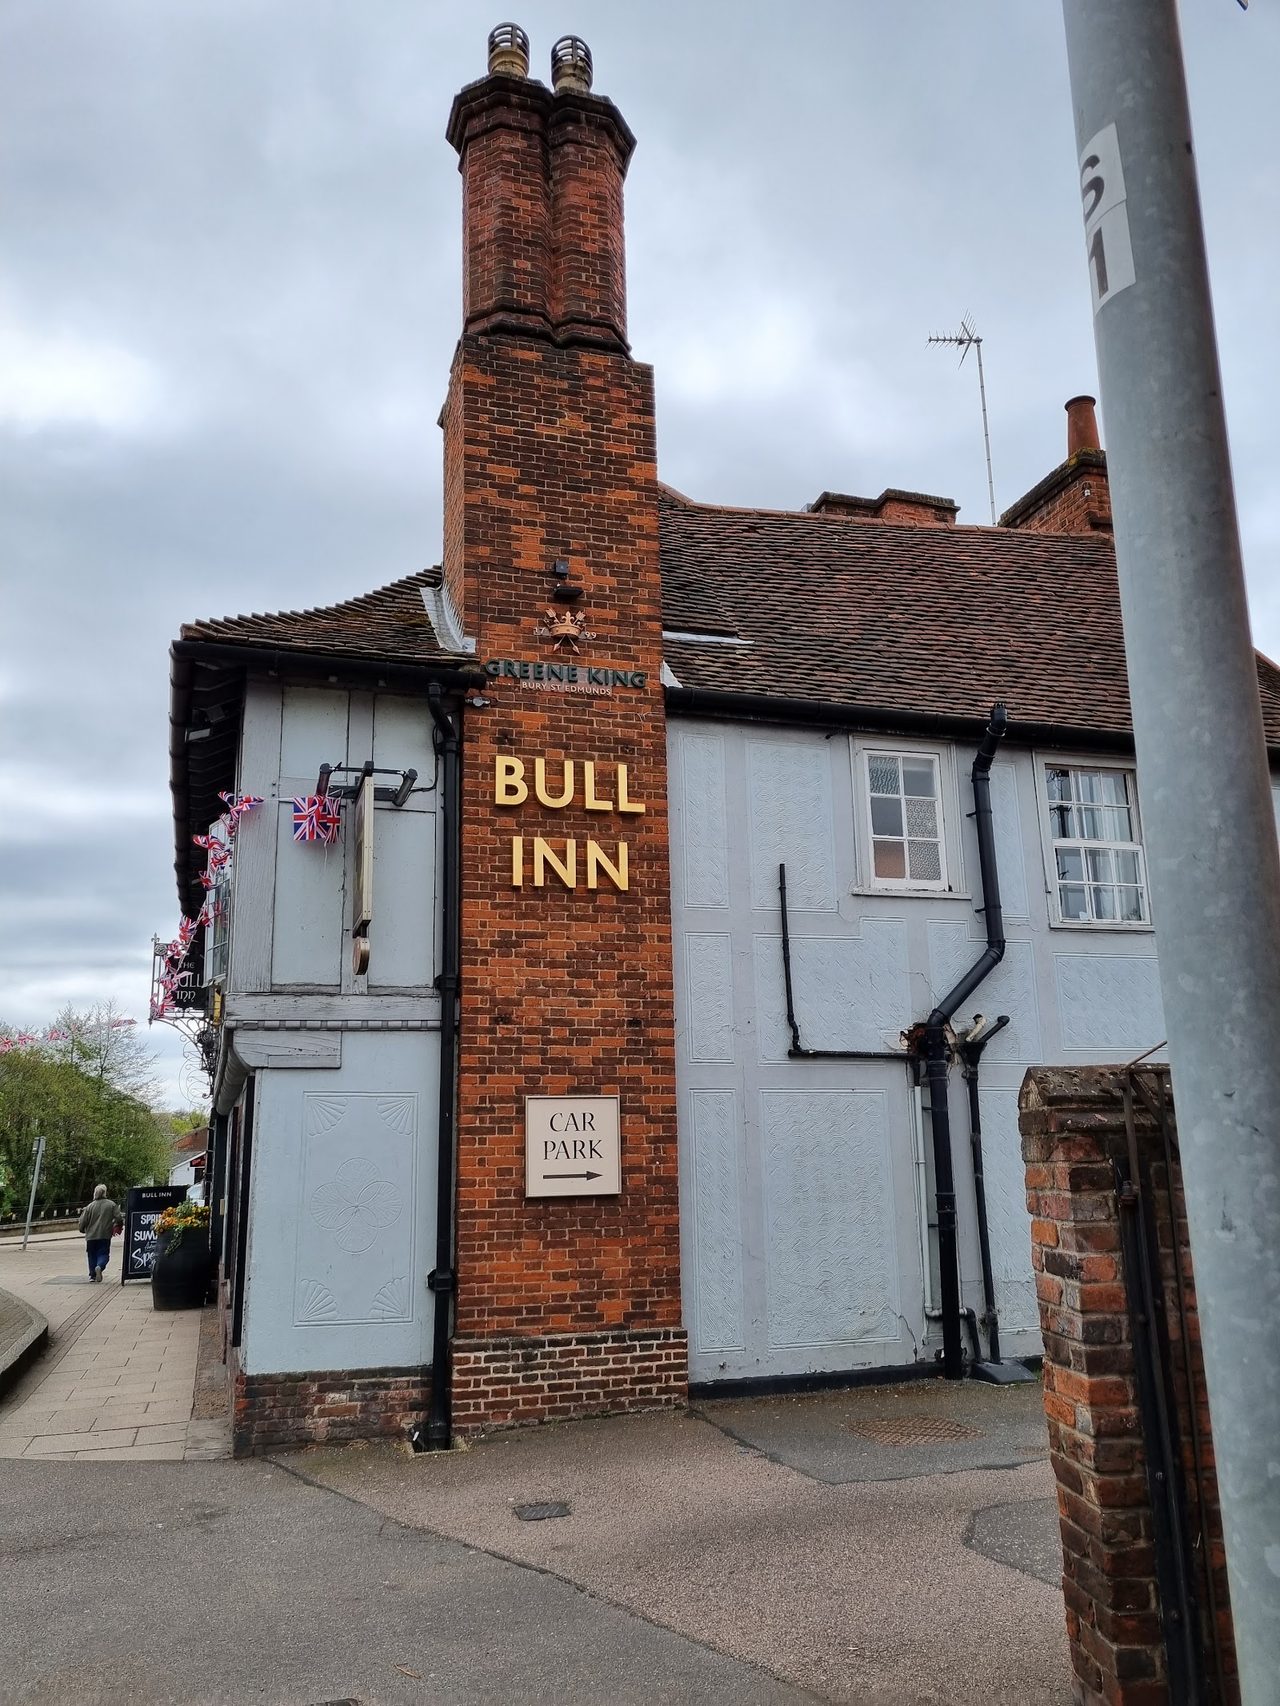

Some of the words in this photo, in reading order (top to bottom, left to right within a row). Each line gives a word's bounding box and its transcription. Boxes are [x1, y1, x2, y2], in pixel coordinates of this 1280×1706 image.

[485, 658, 579, 682] GREENE
[588, 667, 648, 688] KING
[522, 681, 547, 691] BURY
[550, 684, 561, 692] ST
[565, 684, 612, 696] EDMUNDS
[495, 755, 646, 814] BULL
[512, 836, 629, 891] INN
[174, 973, 204, 988] ULL
[549, 1112, 596, 1132] CAR
[543, 1139, 604, 1160] PARK
[140, 1214, 161, 1225] SPRI
[134, 1230, 158, 1241] SUM
[132, 1247, 155, 1269] Spe
